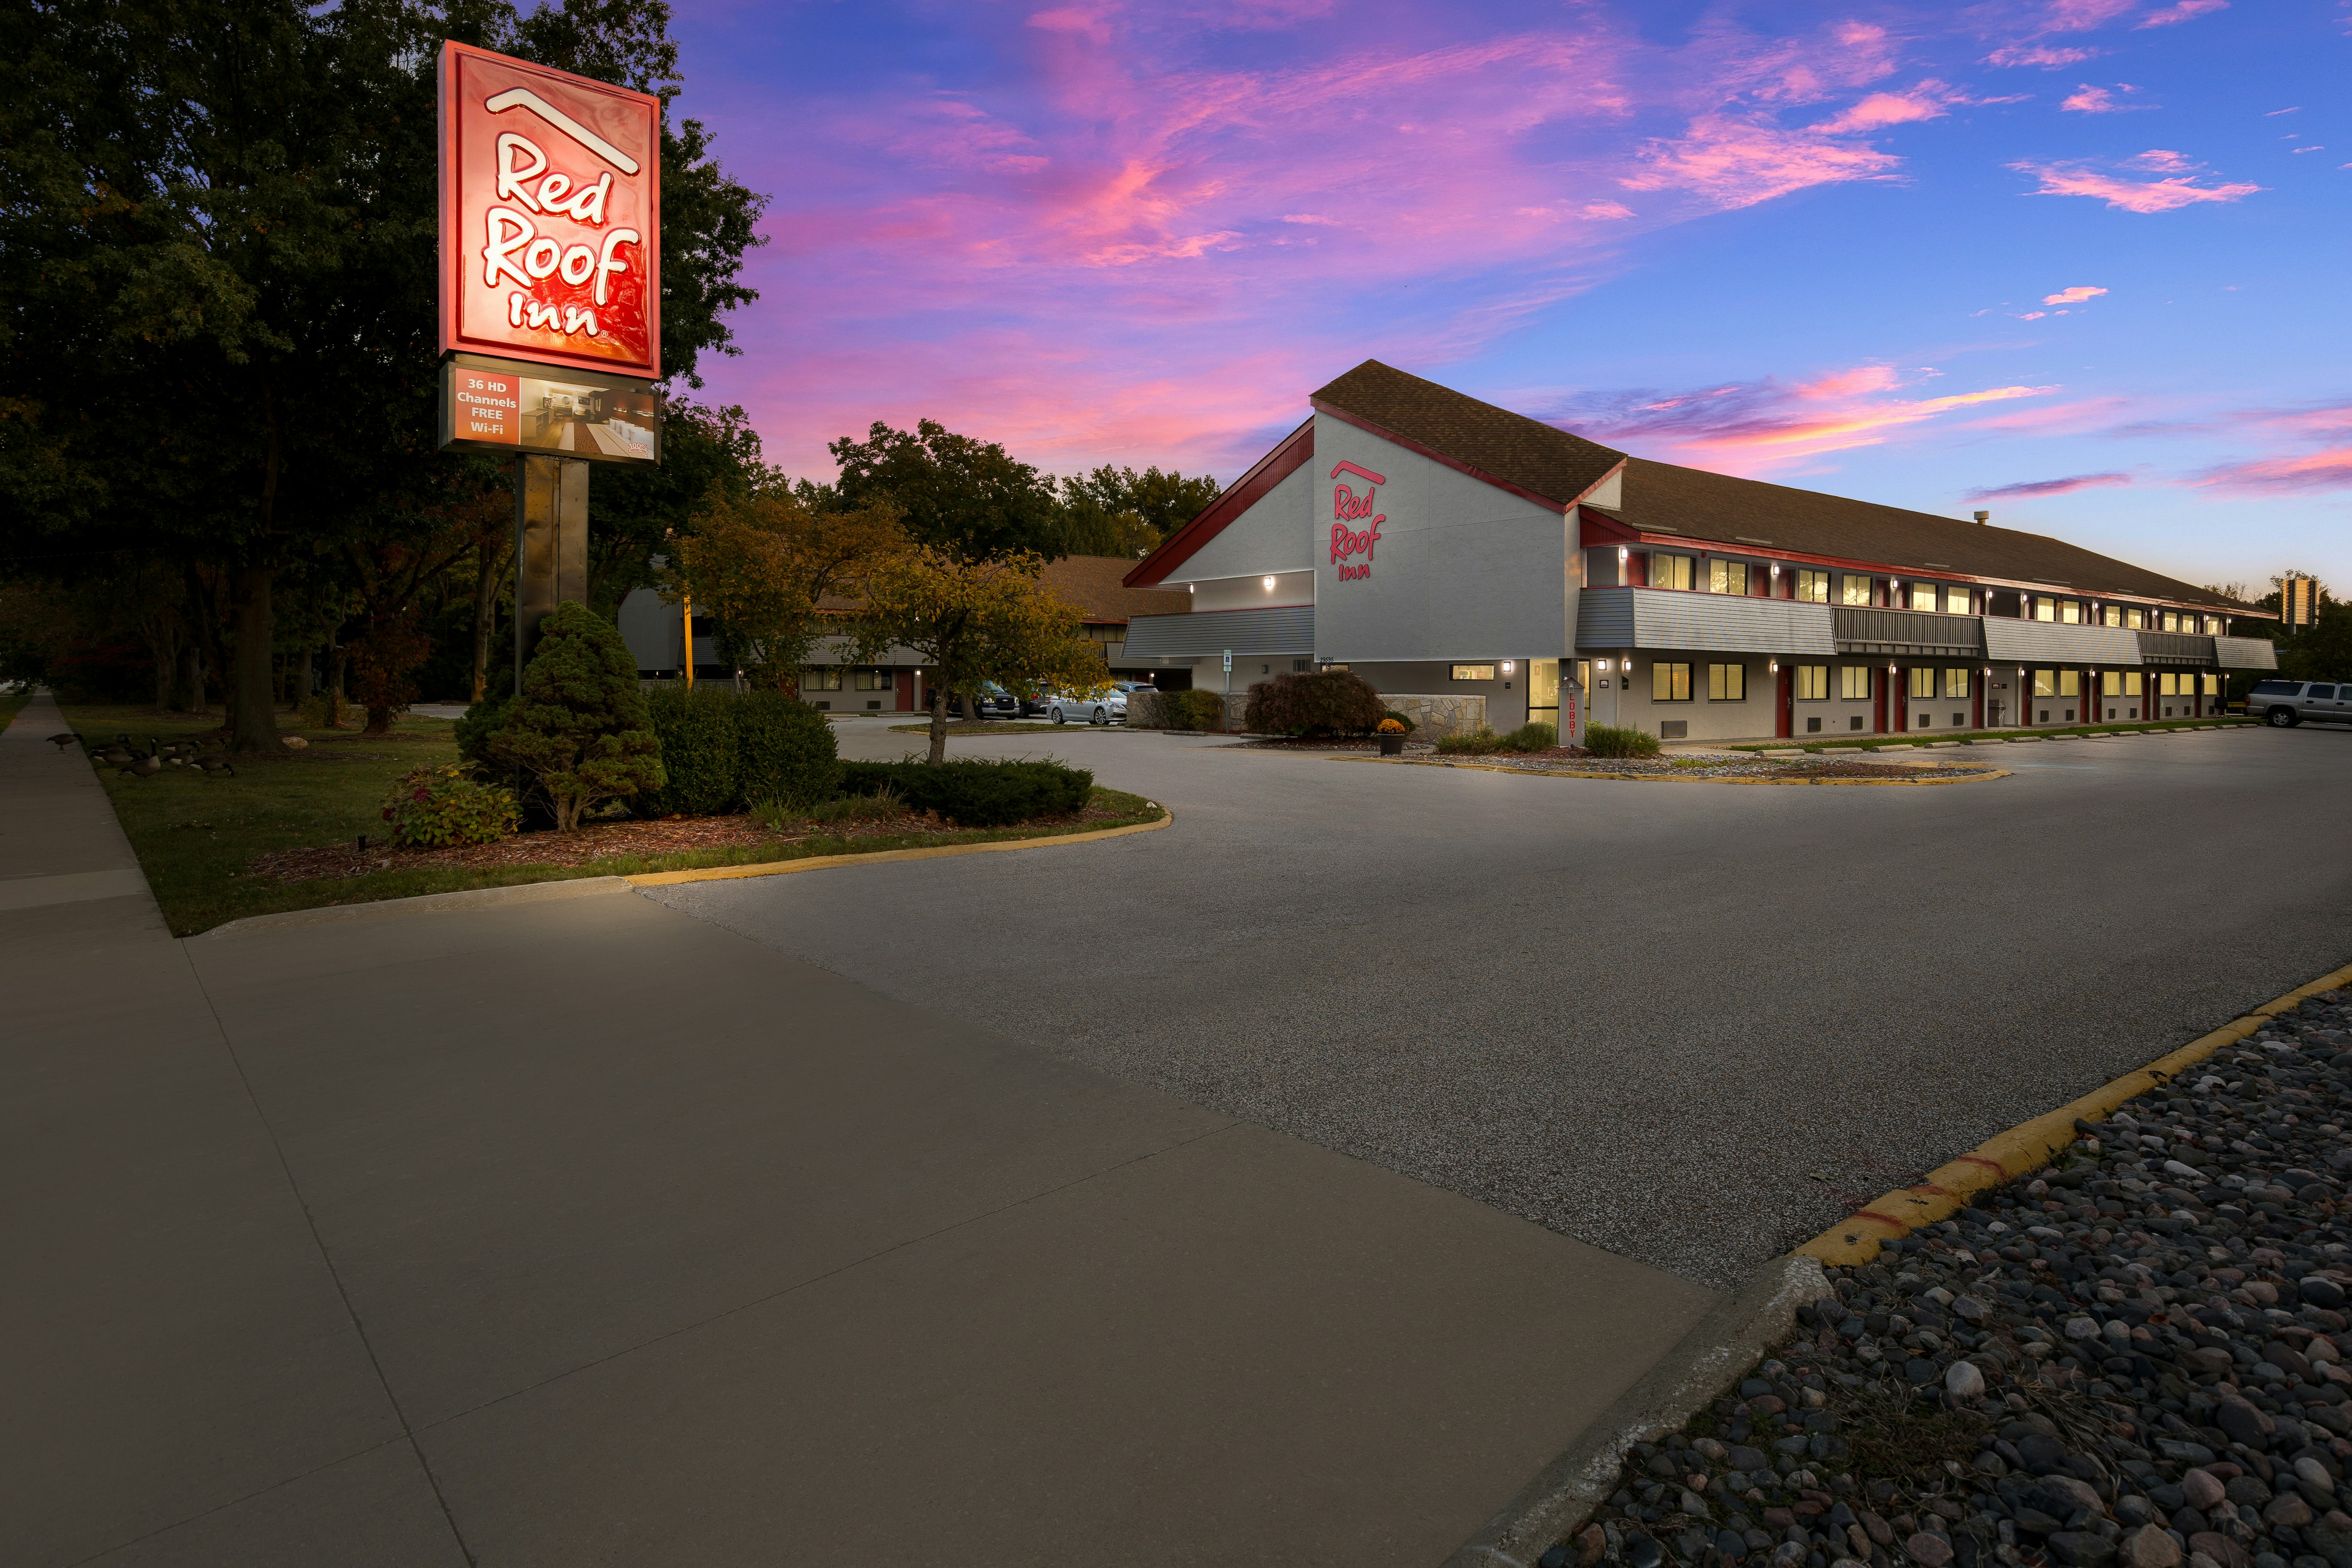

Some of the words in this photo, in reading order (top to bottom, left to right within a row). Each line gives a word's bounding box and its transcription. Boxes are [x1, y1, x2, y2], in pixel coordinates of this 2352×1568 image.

[497, 132, 612, 225] Red
[484, 207, 639, 305] Roof
[509, 293, 599, 336] Inn
[468, 379, 484, 390] 36
[488, 381, 507, 393] HD
[457, 392, 516, 408] Channels
[472, 407, 503, 420] FREE
[470, 421, 503, 435] Wi-Fi
[628, 442, 648, 451] 100%
[1335, 484, 1375, 521] Red
[1330, 514, 1386, 565] Roof
[1339, 564, 1370, 581] Inn
